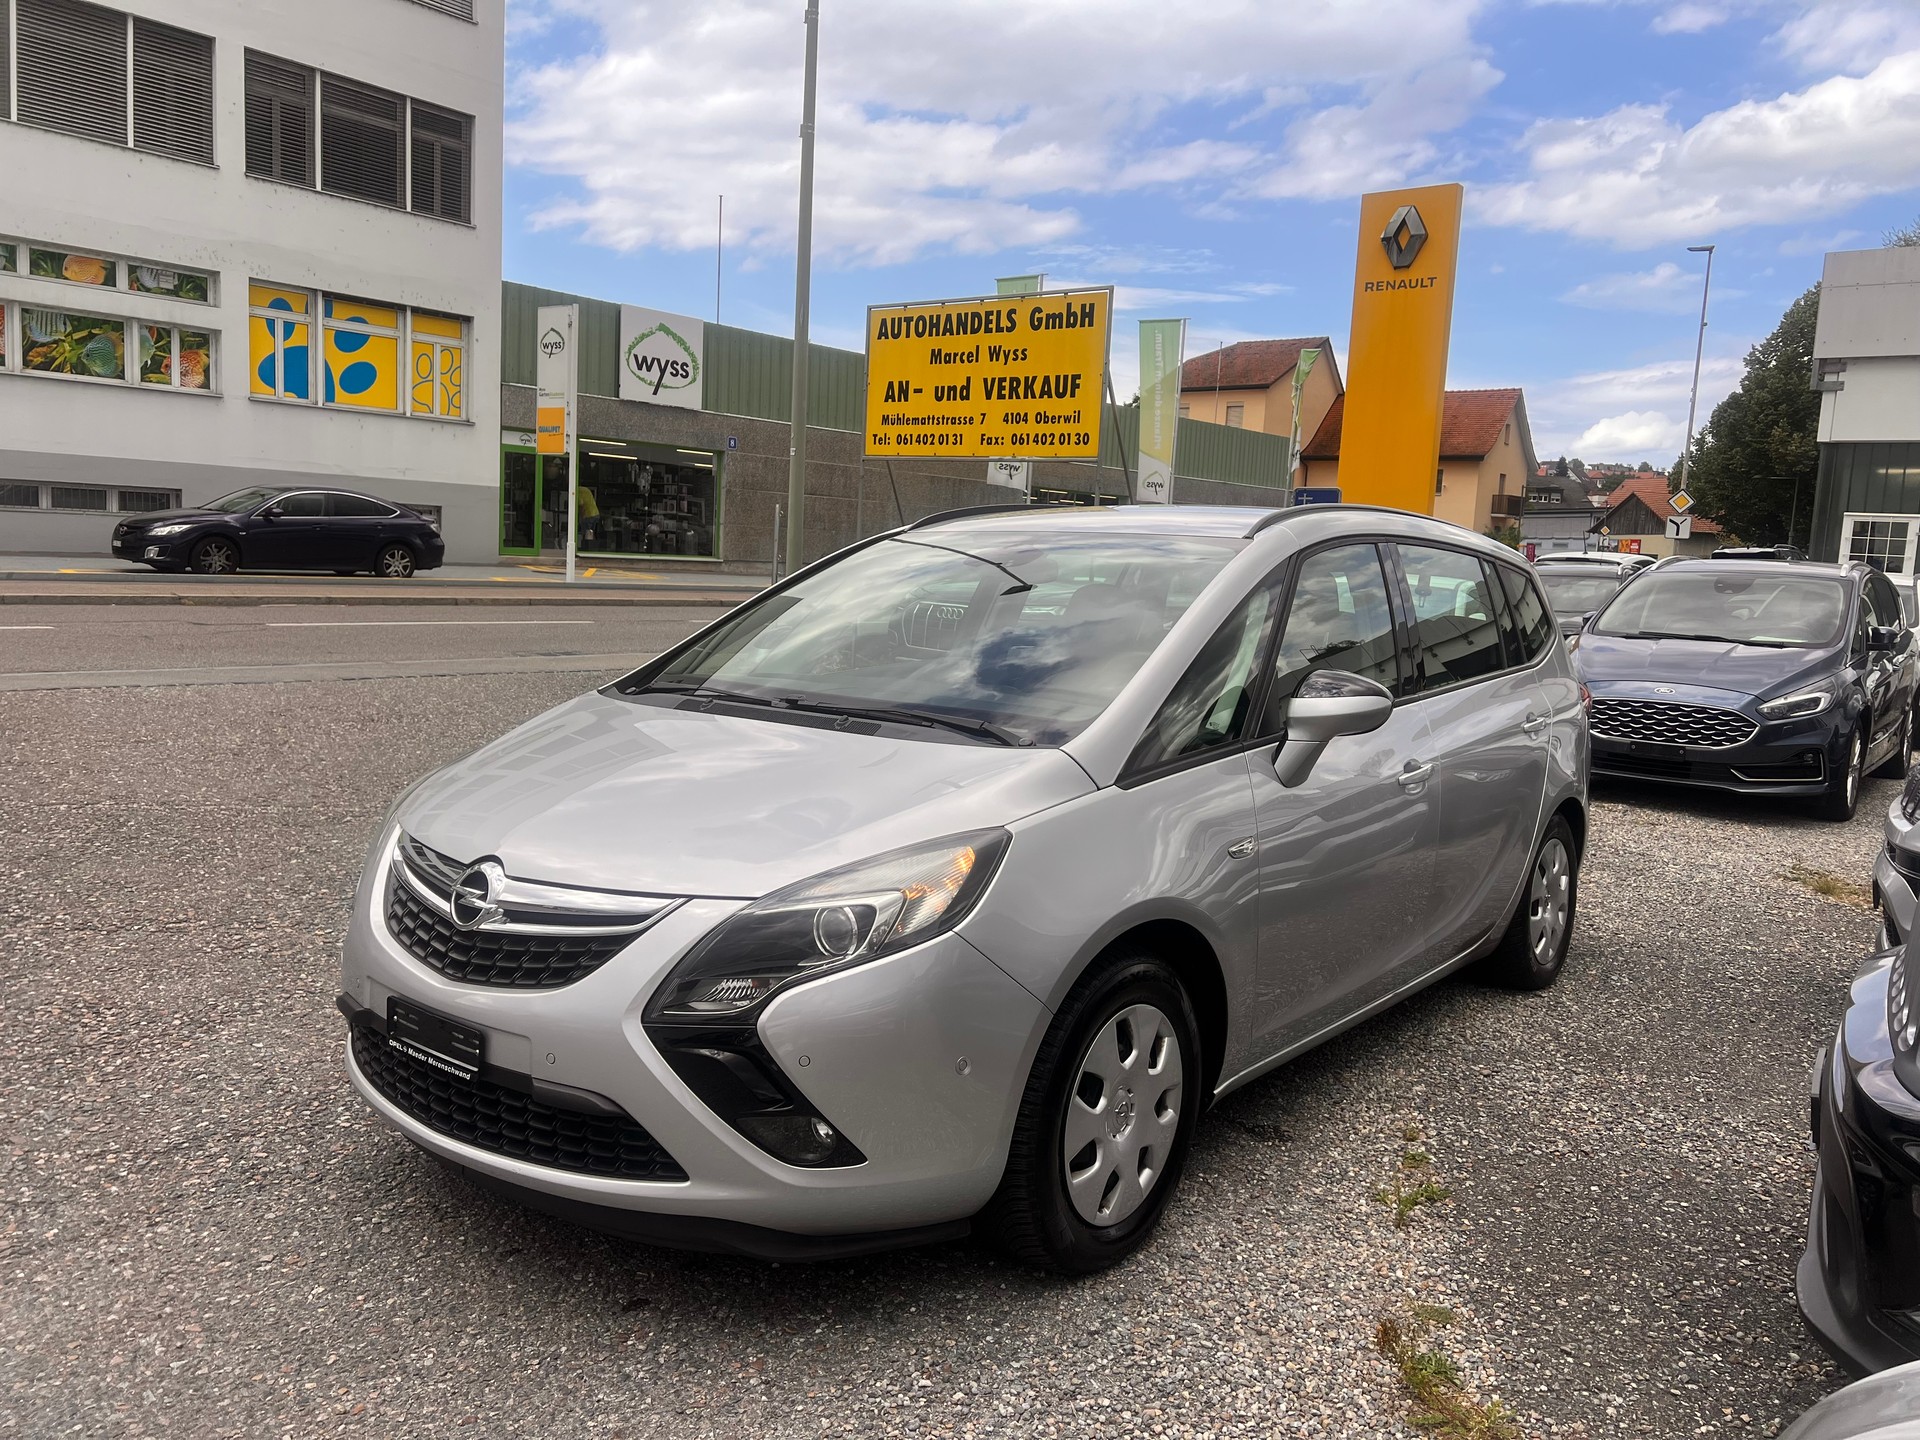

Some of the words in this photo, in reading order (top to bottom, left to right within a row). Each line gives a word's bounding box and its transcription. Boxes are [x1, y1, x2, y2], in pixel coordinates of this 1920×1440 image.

[1365, 277, 1437, 292] RENAULT
[877, 308, 1017, 340] AUTOHANDELS
[1030, 302, 1095, 331] GmbH
[542, 341, 562, 359] wyss
[930, 345, 979, 364] Marcel
[988, 345, 1027, 365] Wyss
[633, 353, 690, 396] wyss
[935, 376, 971, 402] und
[983, 374, 1081, 400] VERKAUF
[882, 413, 974, 425] Mühlemattstrasse
[980, 413, 986, 424] 7
[1003, 412, 1028, 424] 4104
[1035, 410, 1080, 424] Oberwil
[873, 433, 890, 445] Tel:
[980, 433, 1004, 445] Fax:
